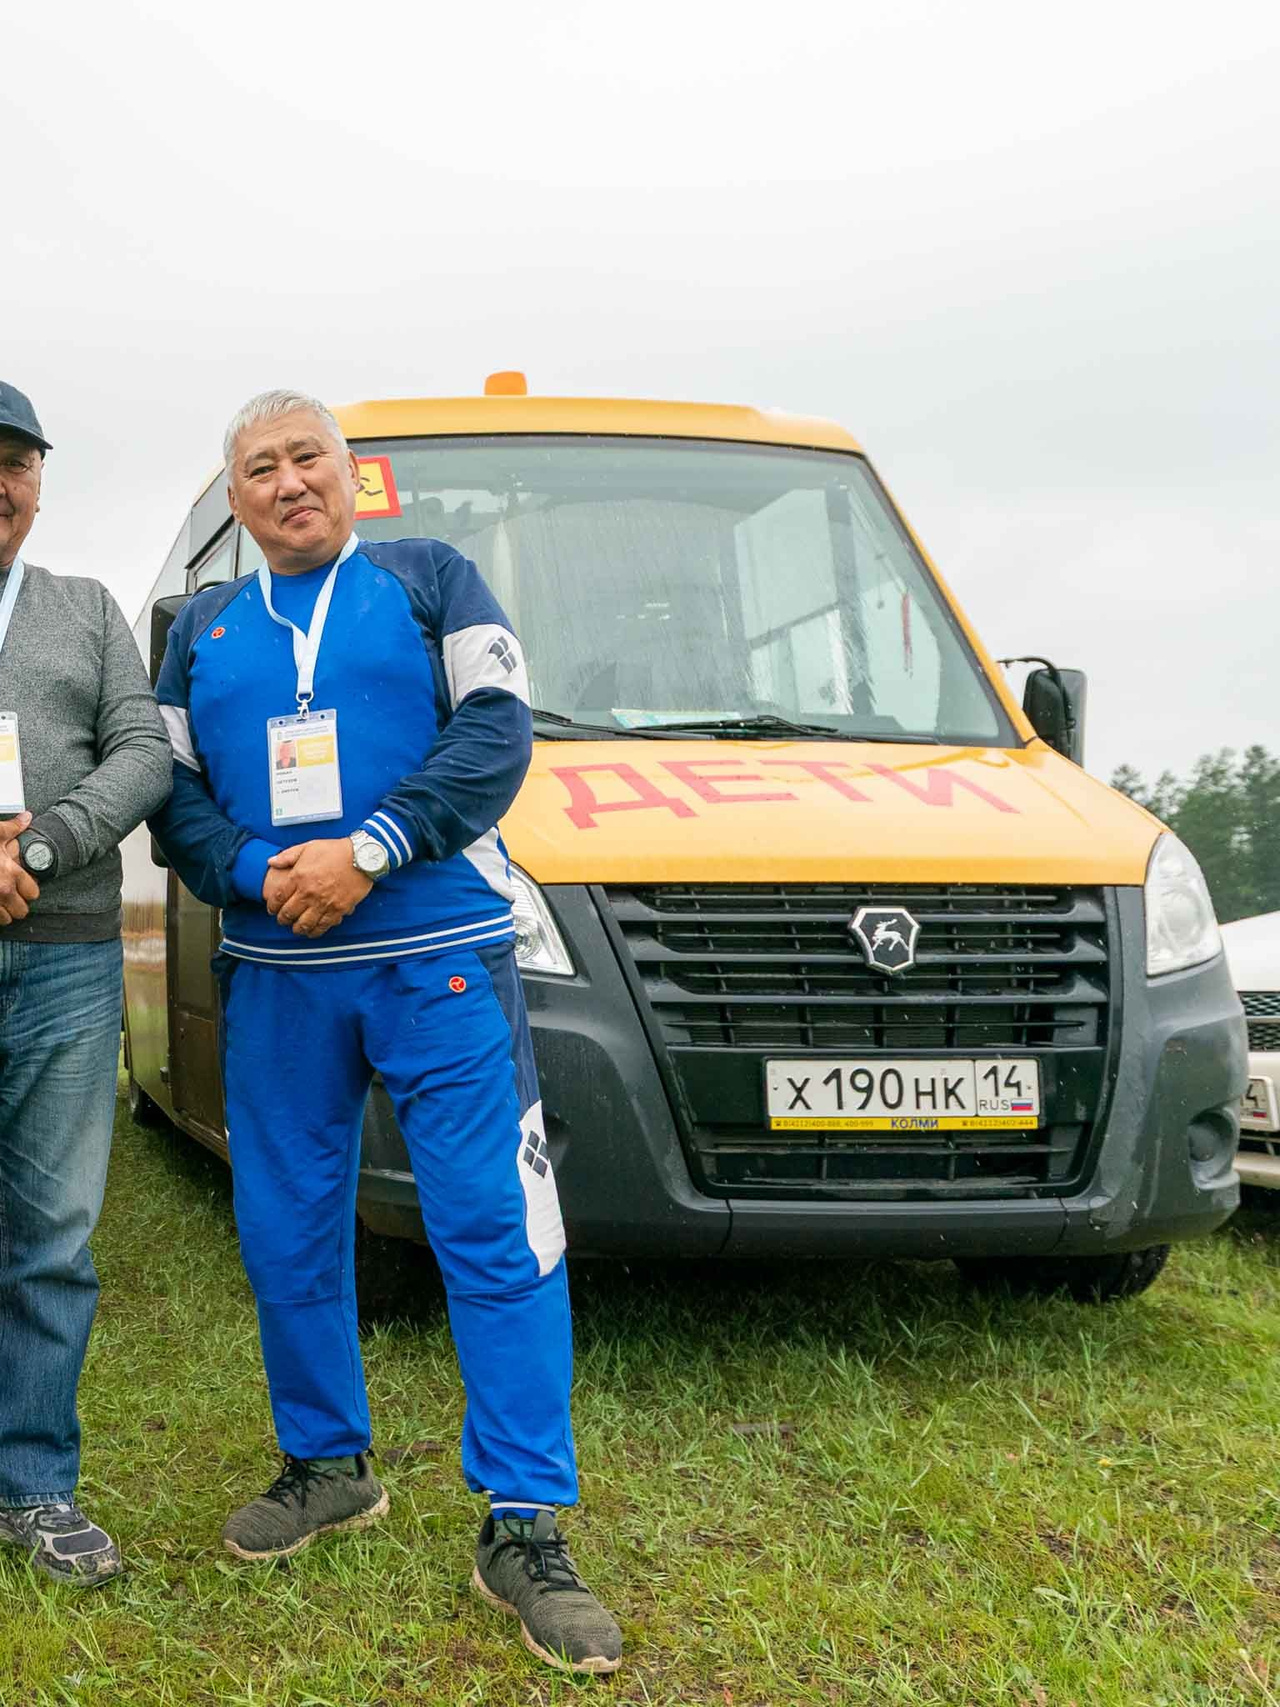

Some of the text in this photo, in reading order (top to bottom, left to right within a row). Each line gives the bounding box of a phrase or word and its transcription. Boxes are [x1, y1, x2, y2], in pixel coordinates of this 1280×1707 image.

[549, 759, 1021, 829] ДЕТИ
[983, 1065, 1023, 1097] 14
[979, 1099, 1010, 1111] RUS
[891, 1119, 939, 1129] КОЛМИ
